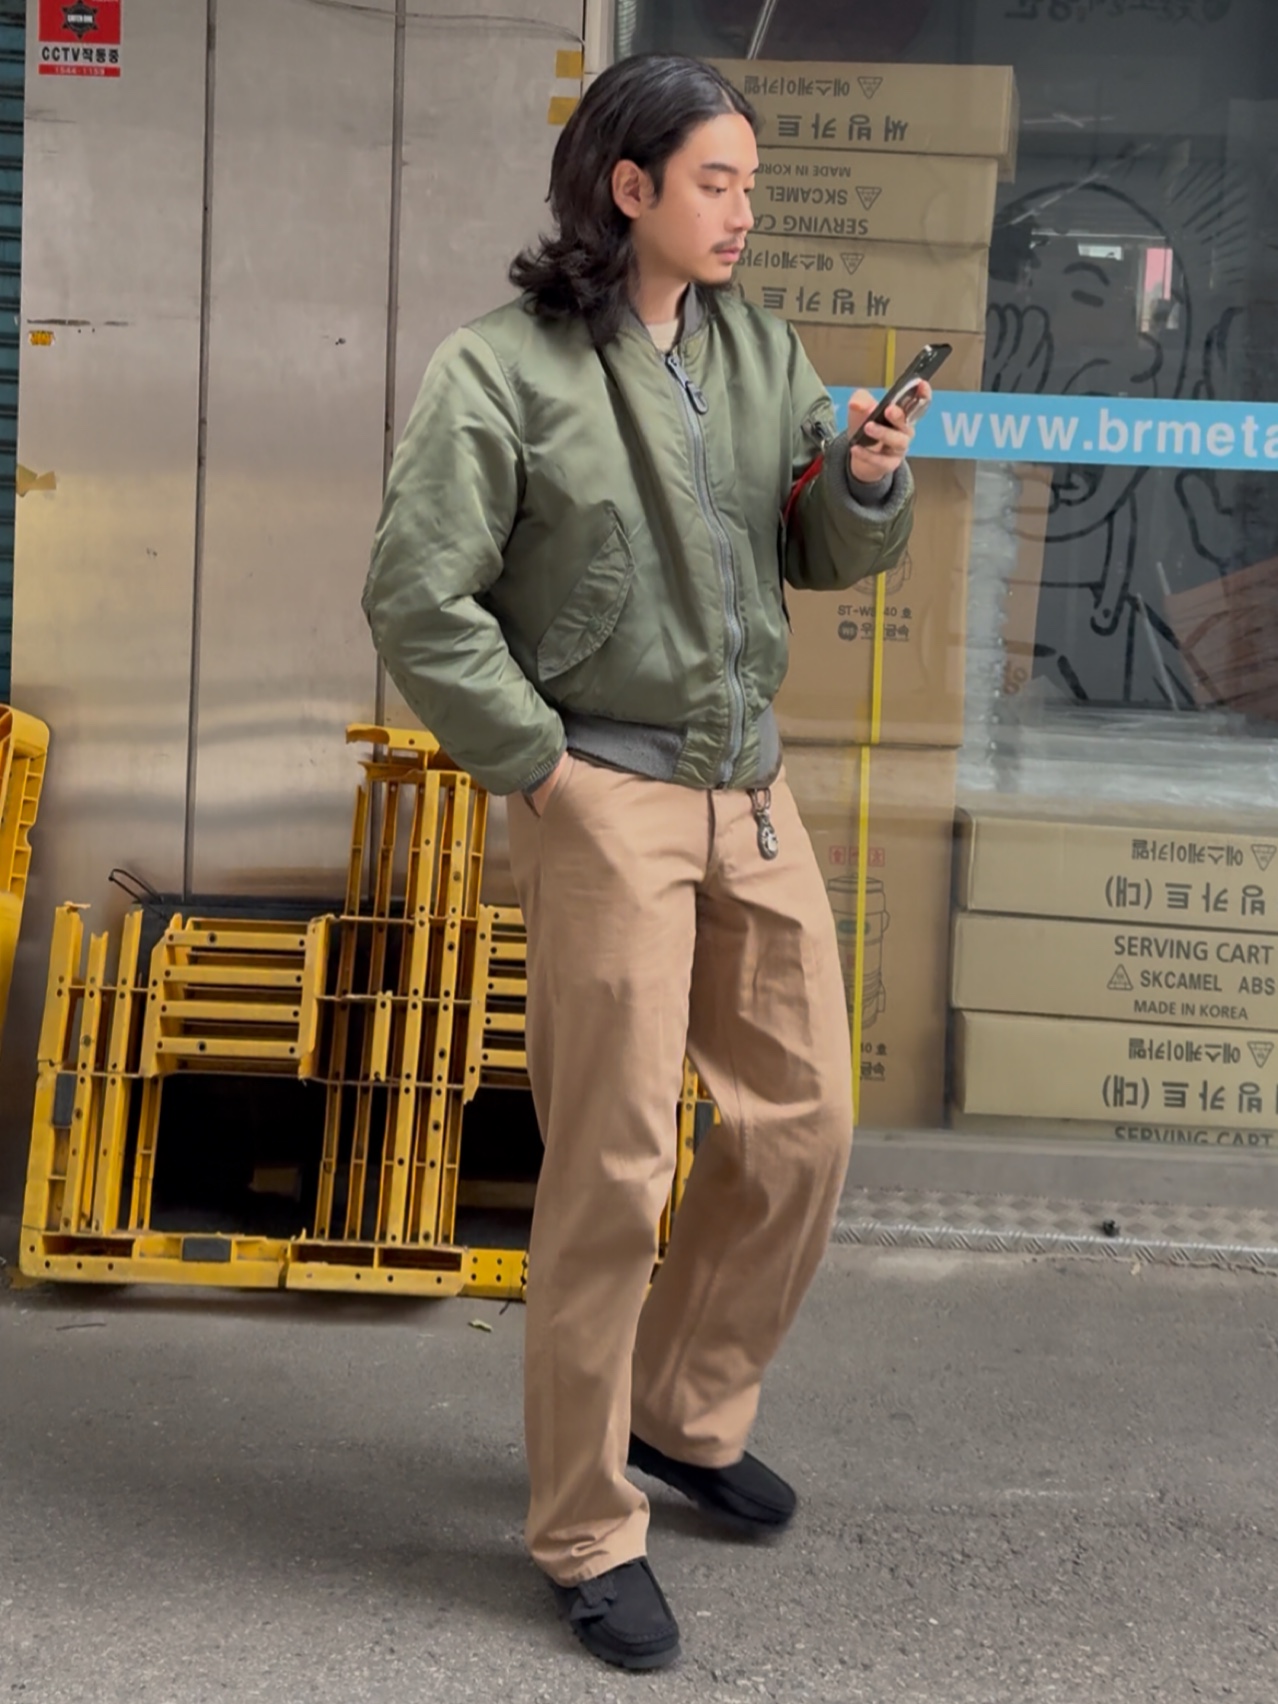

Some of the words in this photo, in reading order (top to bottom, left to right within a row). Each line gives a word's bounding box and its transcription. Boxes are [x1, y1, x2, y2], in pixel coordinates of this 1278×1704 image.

[41, 46, 119, 63] CCTV작동중
[744, 75, 850, 97] 에스케이카멜
[795, 165, 809, 176] IN
[813, 166, 851, 178] MADE
[766, 186, 848, 205] SKCAMEL
[753, 214, 776, 231] CA
[783, 214, 869, 235] SERVING
[860, 622, 909, 638] 우금속
[1132, 839, 1243, 866] 에스케이카멜
[1114, 935, 1208, 961] SERVING
[1216, 942, 1274, 965] CART
[1140, 969, 1222, 992] SKCAMEL
[1238, 976, 1276, 996] ABS
[1134, 1000, 1176, 1015] MADE
[1181, 1002, 1196, 1016] IN
[1200, 1004, 1248, 1020] KOREA
[1129, 1037, 1240, 1064] 에스케이카멜
